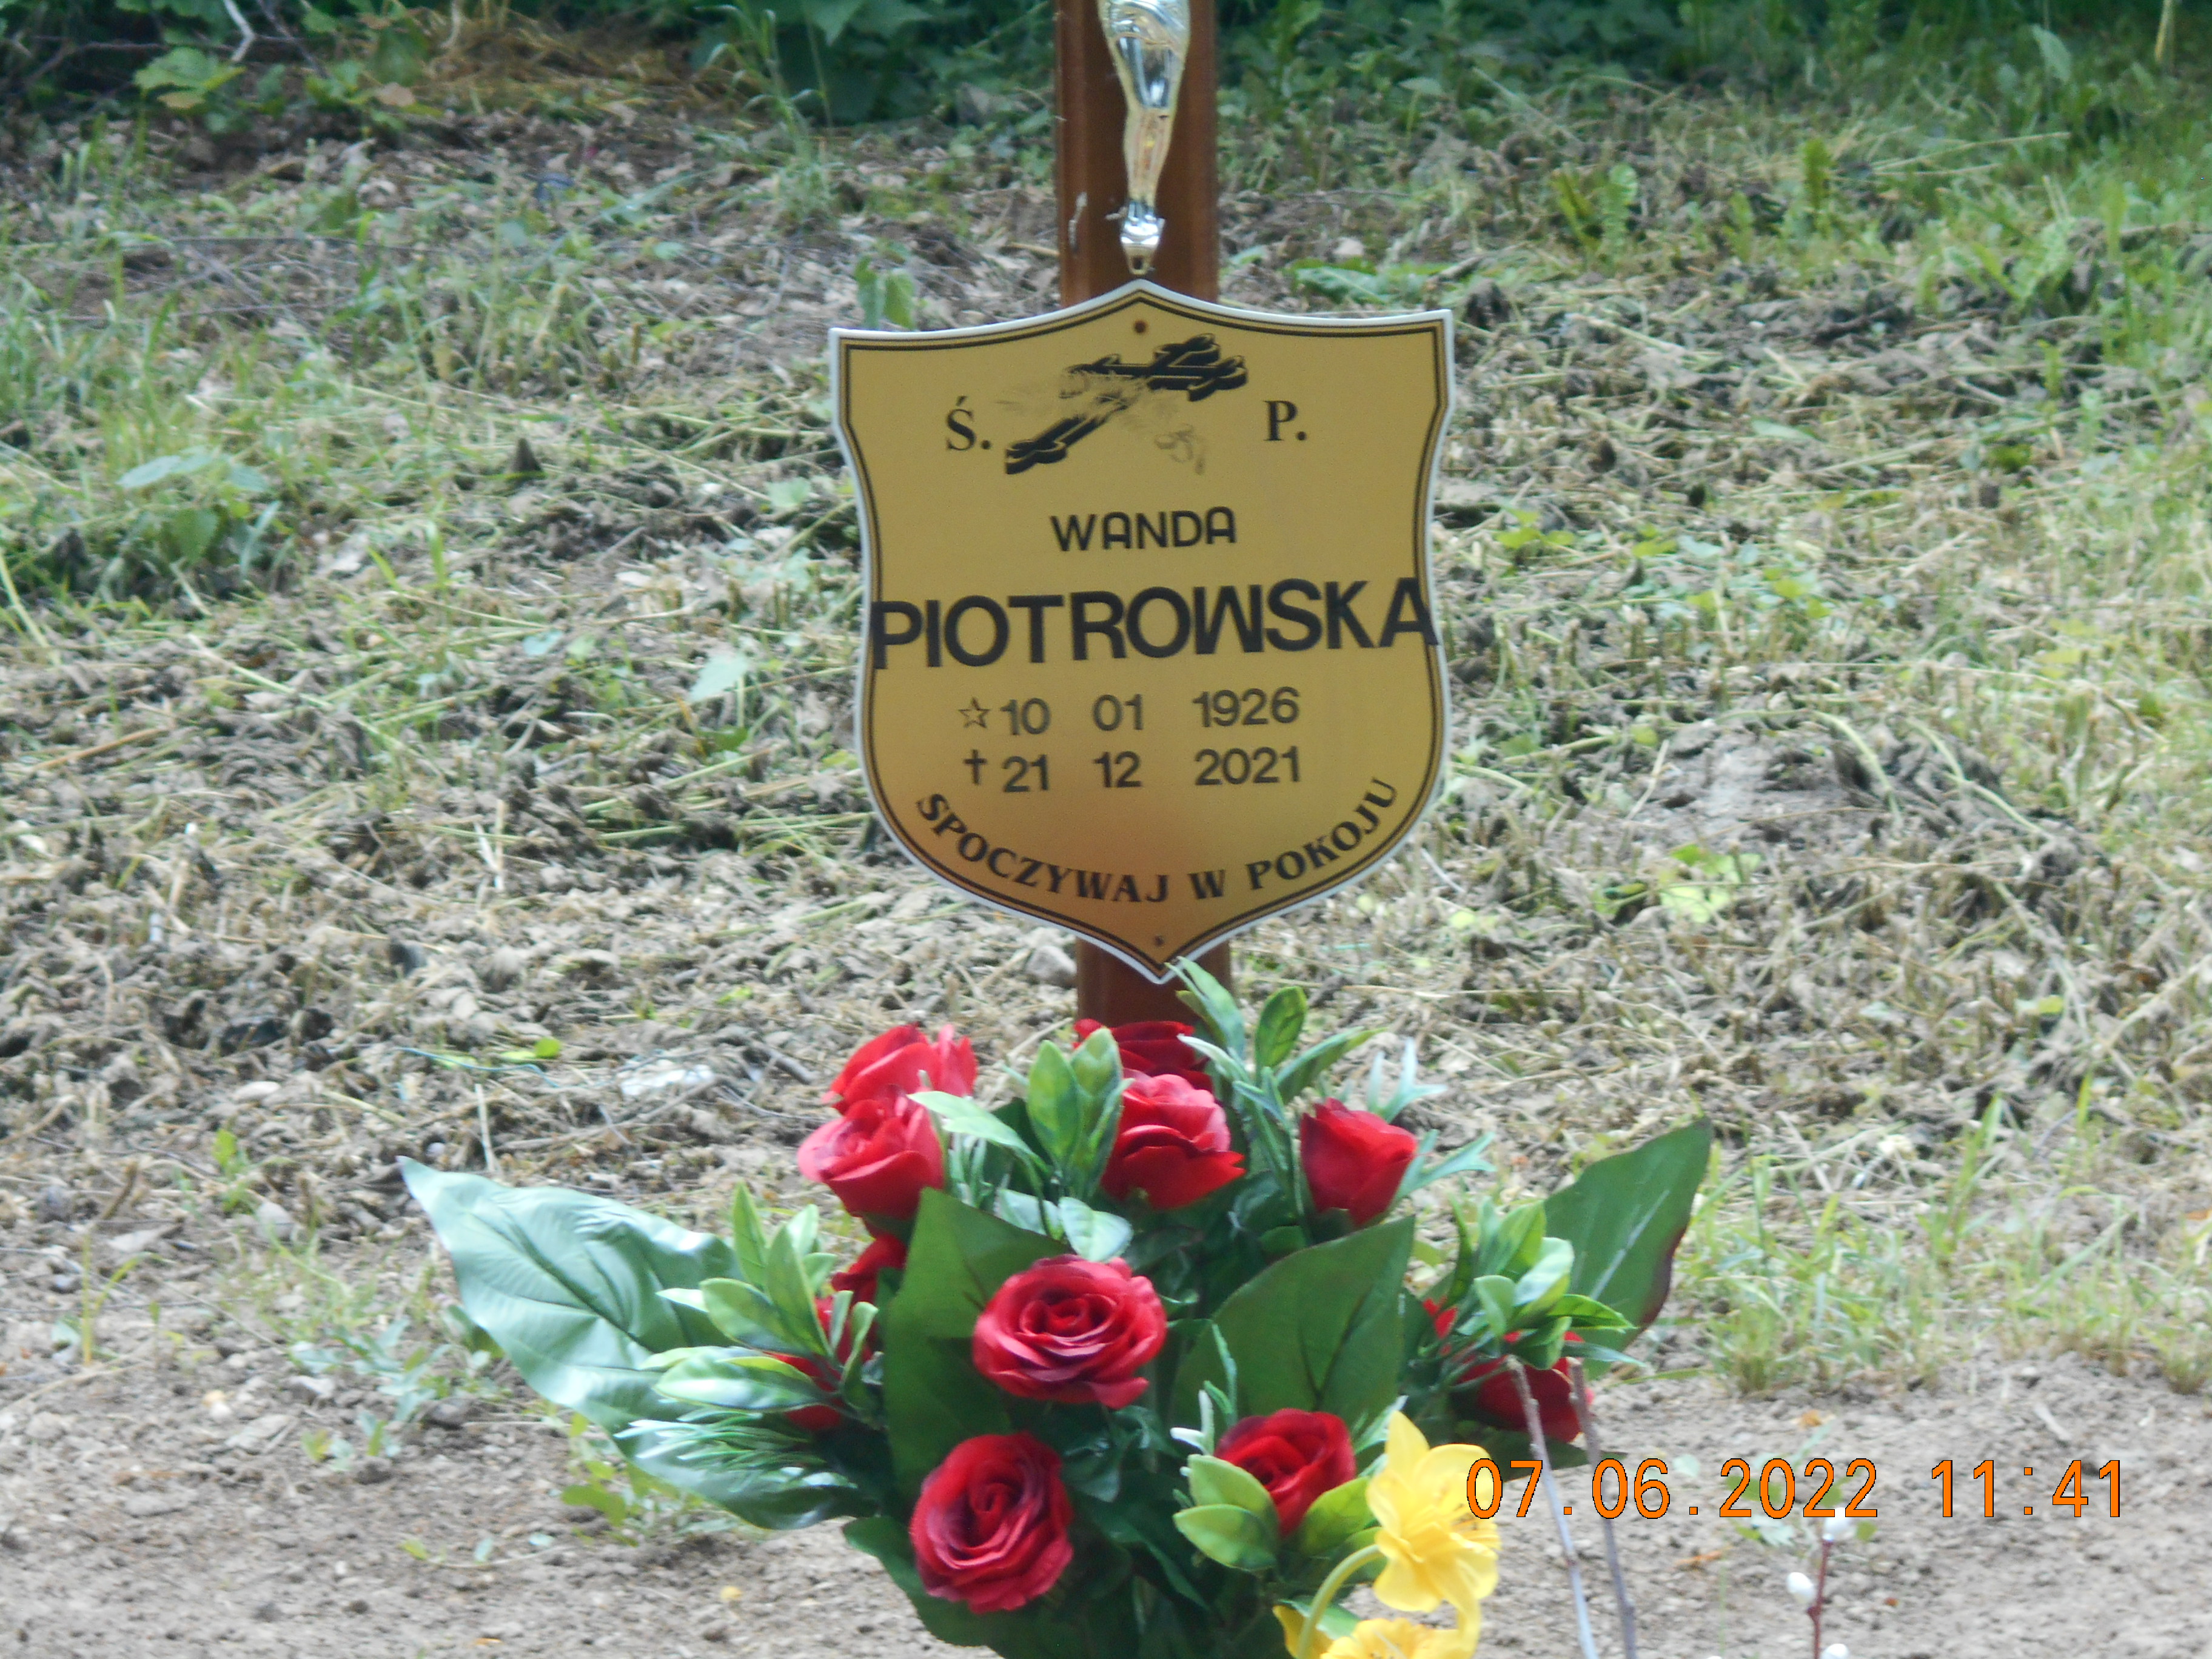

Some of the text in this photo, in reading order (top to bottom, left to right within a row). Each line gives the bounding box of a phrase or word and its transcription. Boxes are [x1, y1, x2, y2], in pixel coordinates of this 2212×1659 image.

[943, 395, 1307, 452] Ś. P.
[1050, 506, 1237, 552] WANDA
[871, 577, 1439, 671] PIOTROWSKA
[1000, 686, 1300, 736] 10 01 1926
[1002, 746, 1301, 793] 21 12 2021
[916, 776, 1399, 903] SPOCZYWAJ W POKOJU
